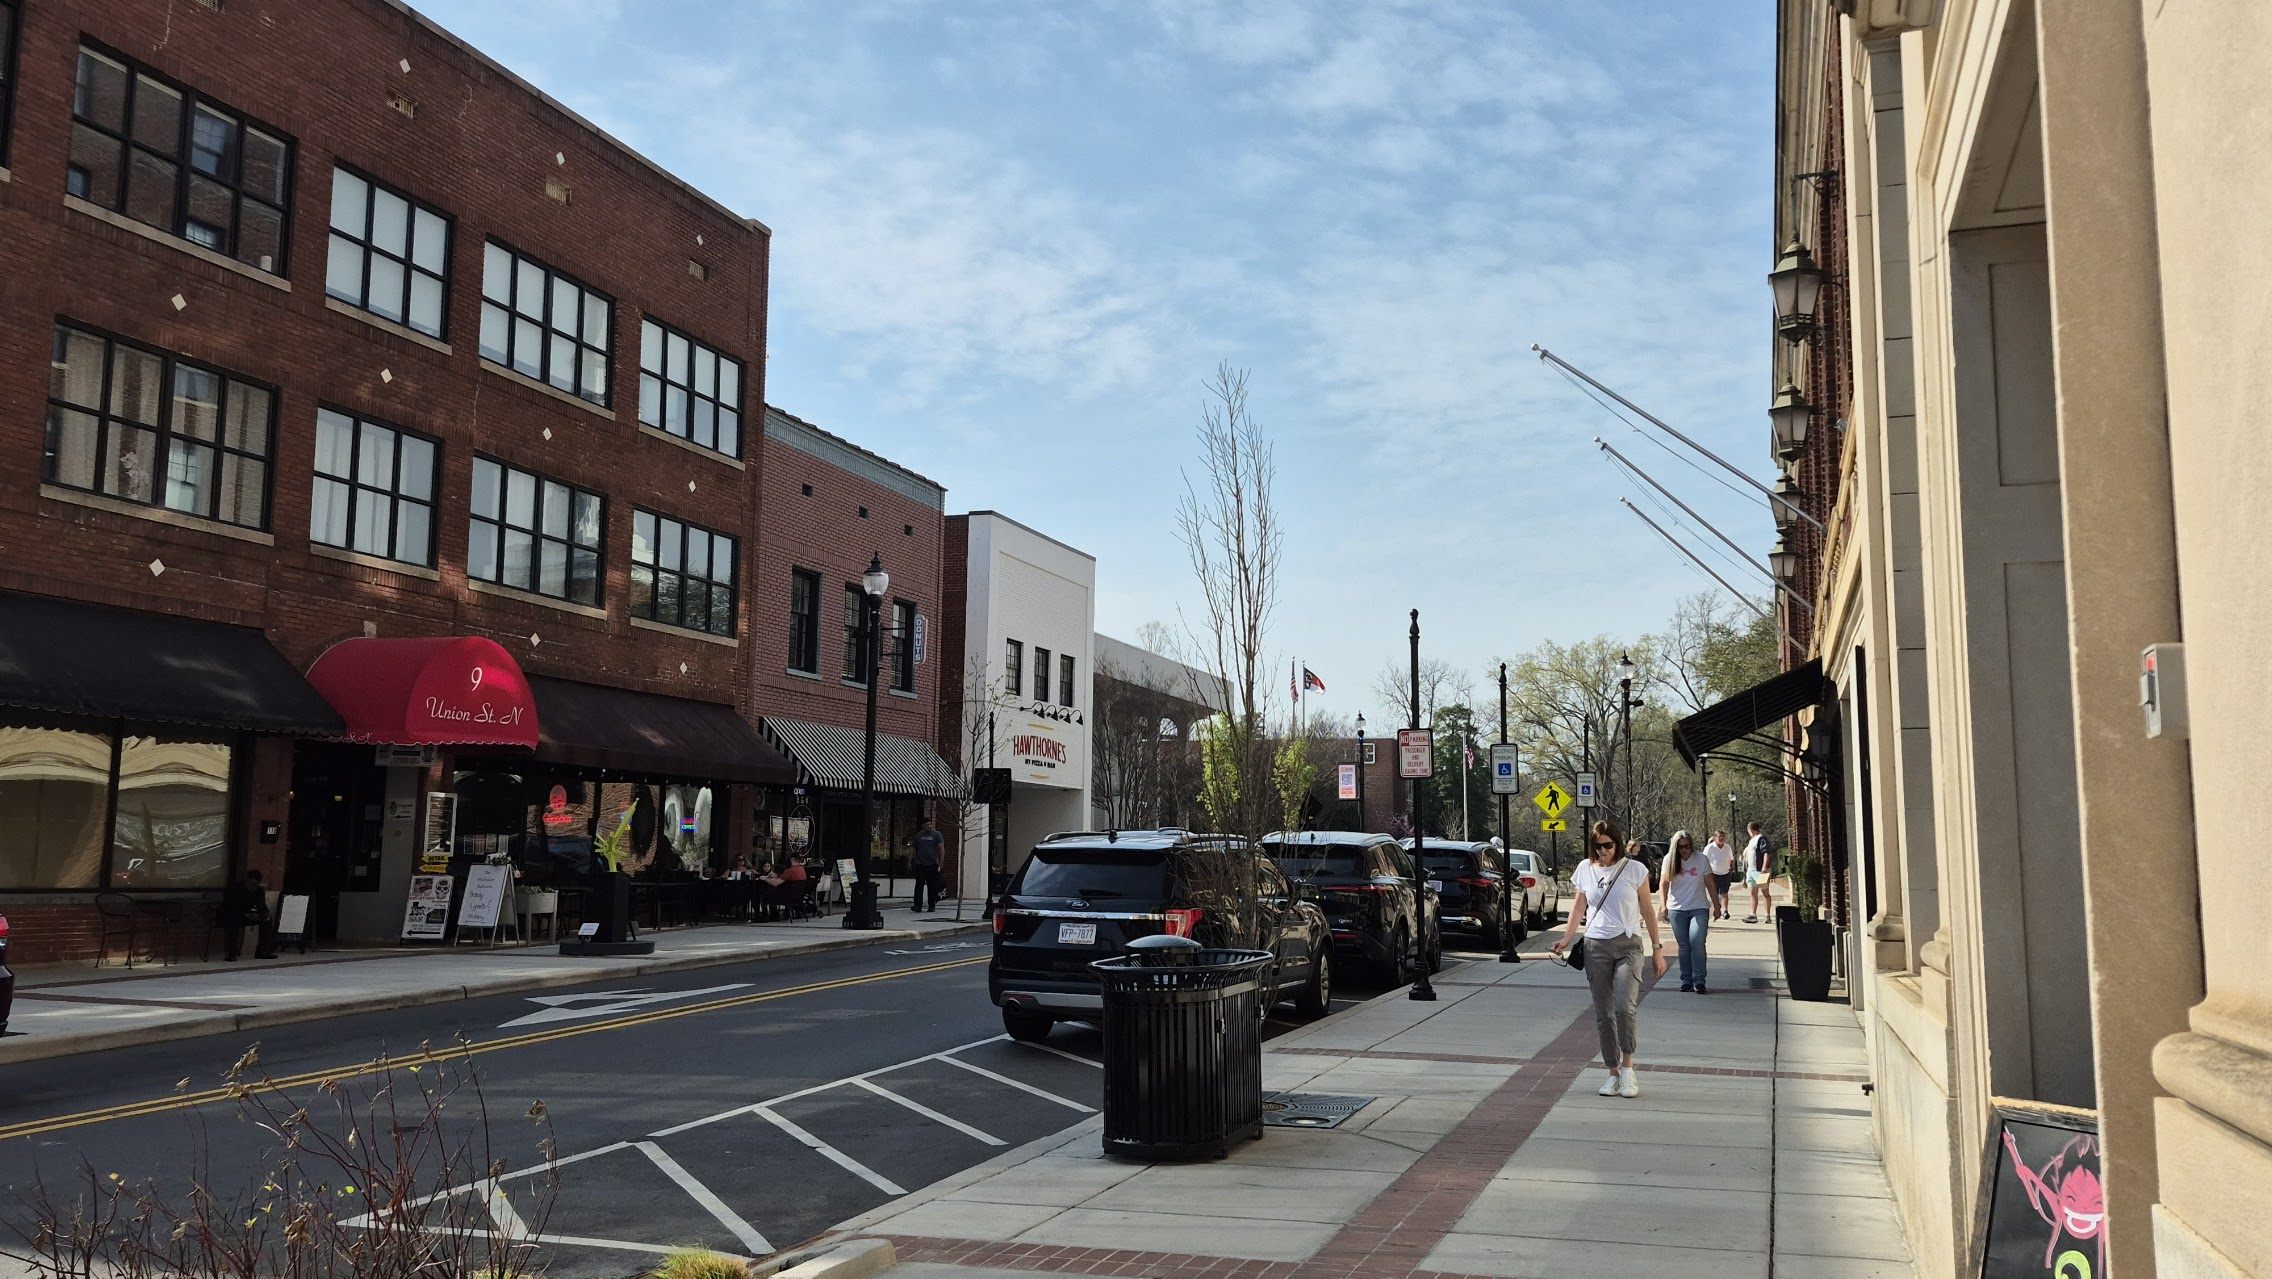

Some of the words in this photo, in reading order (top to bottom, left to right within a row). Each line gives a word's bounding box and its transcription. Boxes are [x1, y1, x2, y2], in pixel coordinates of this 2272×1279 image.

[471, 666, 483, 692] 9
[426, 696, 471, 721] Union
[474, 702, 496, 723] St.
[500, 706, 524, 725] N
[1401, 734, 1409, 744] NO
[1061, 928, 1094, 940] VFP-7877
